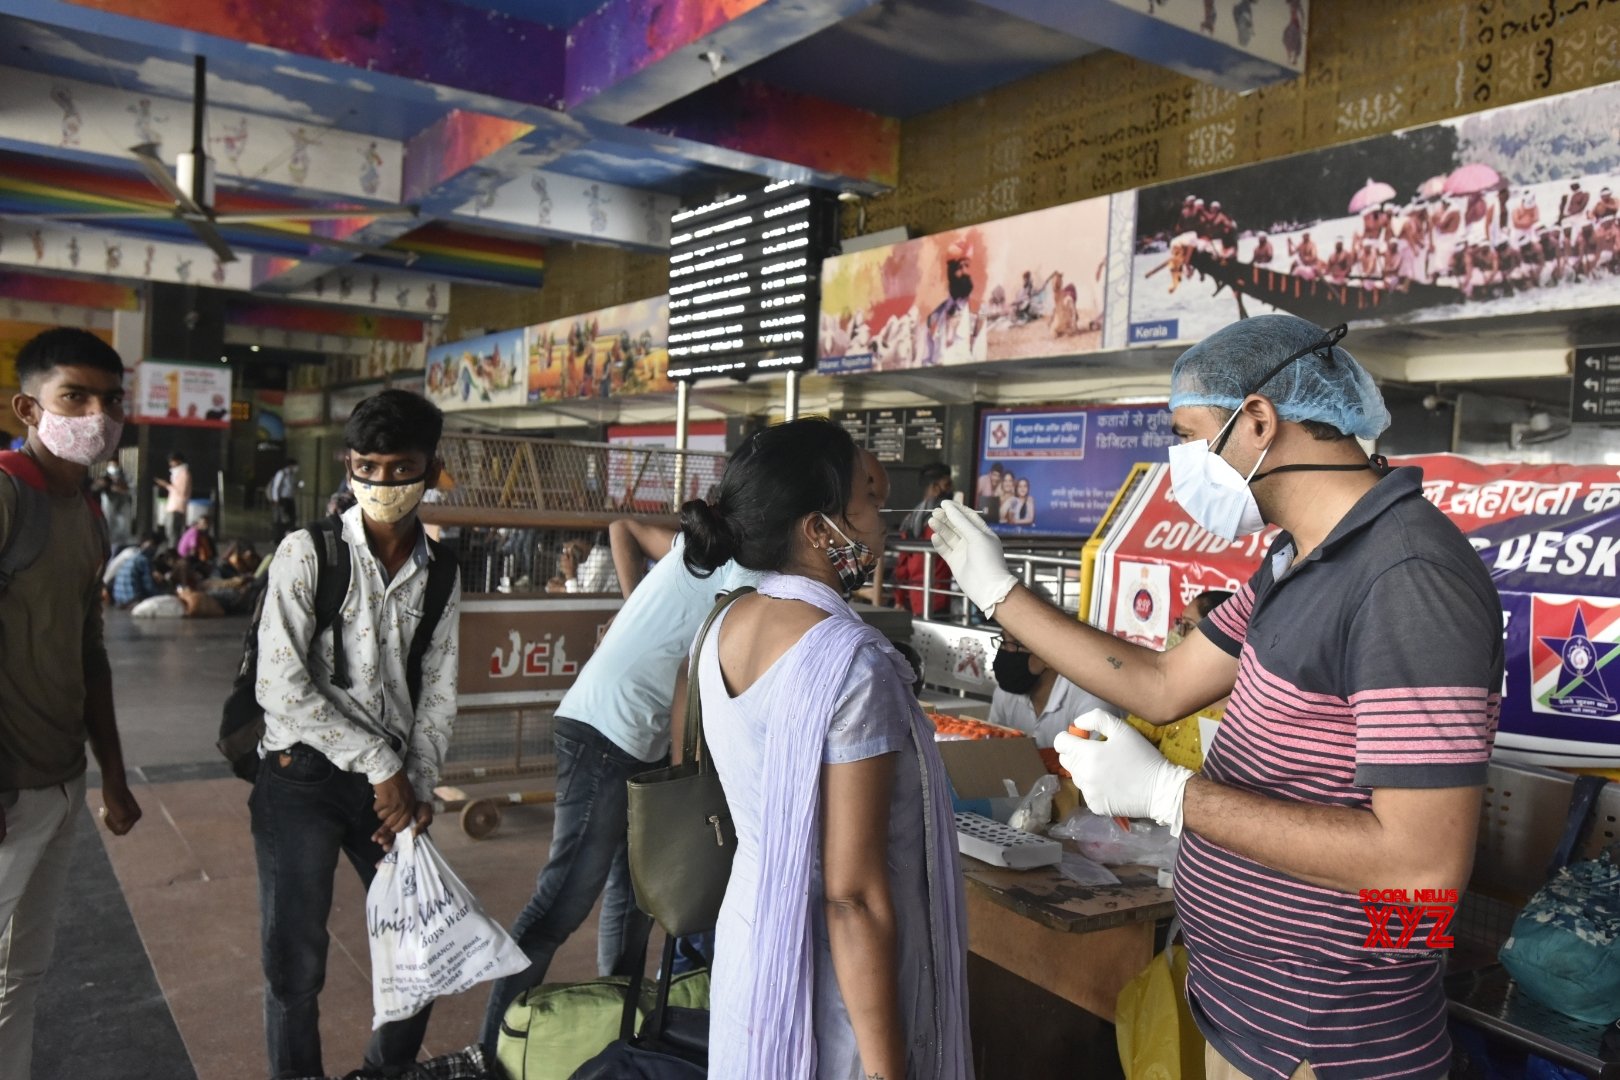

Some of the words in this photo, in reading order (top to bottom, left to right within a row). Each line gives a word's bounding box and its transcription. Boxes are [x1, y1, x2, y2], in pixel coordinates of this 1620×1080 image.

[1135, 325, 1168, 338] Kerala
[1014, 435, 1036, 445] Central
[1036, 435, 1051, 444] Bank
[1053, 434, 1061, 444] of
[1061, 434, 1078, 443] India
[1451, 480, 1582, 518] सहायता
[1493, 531, 1620, 577] DESK
[445, 904, 469, 929] Wear
[427, 941, 456, 966] BRANCH
[447, 950, 463, 966] Main
[447, 957, 467, 975] Palam
